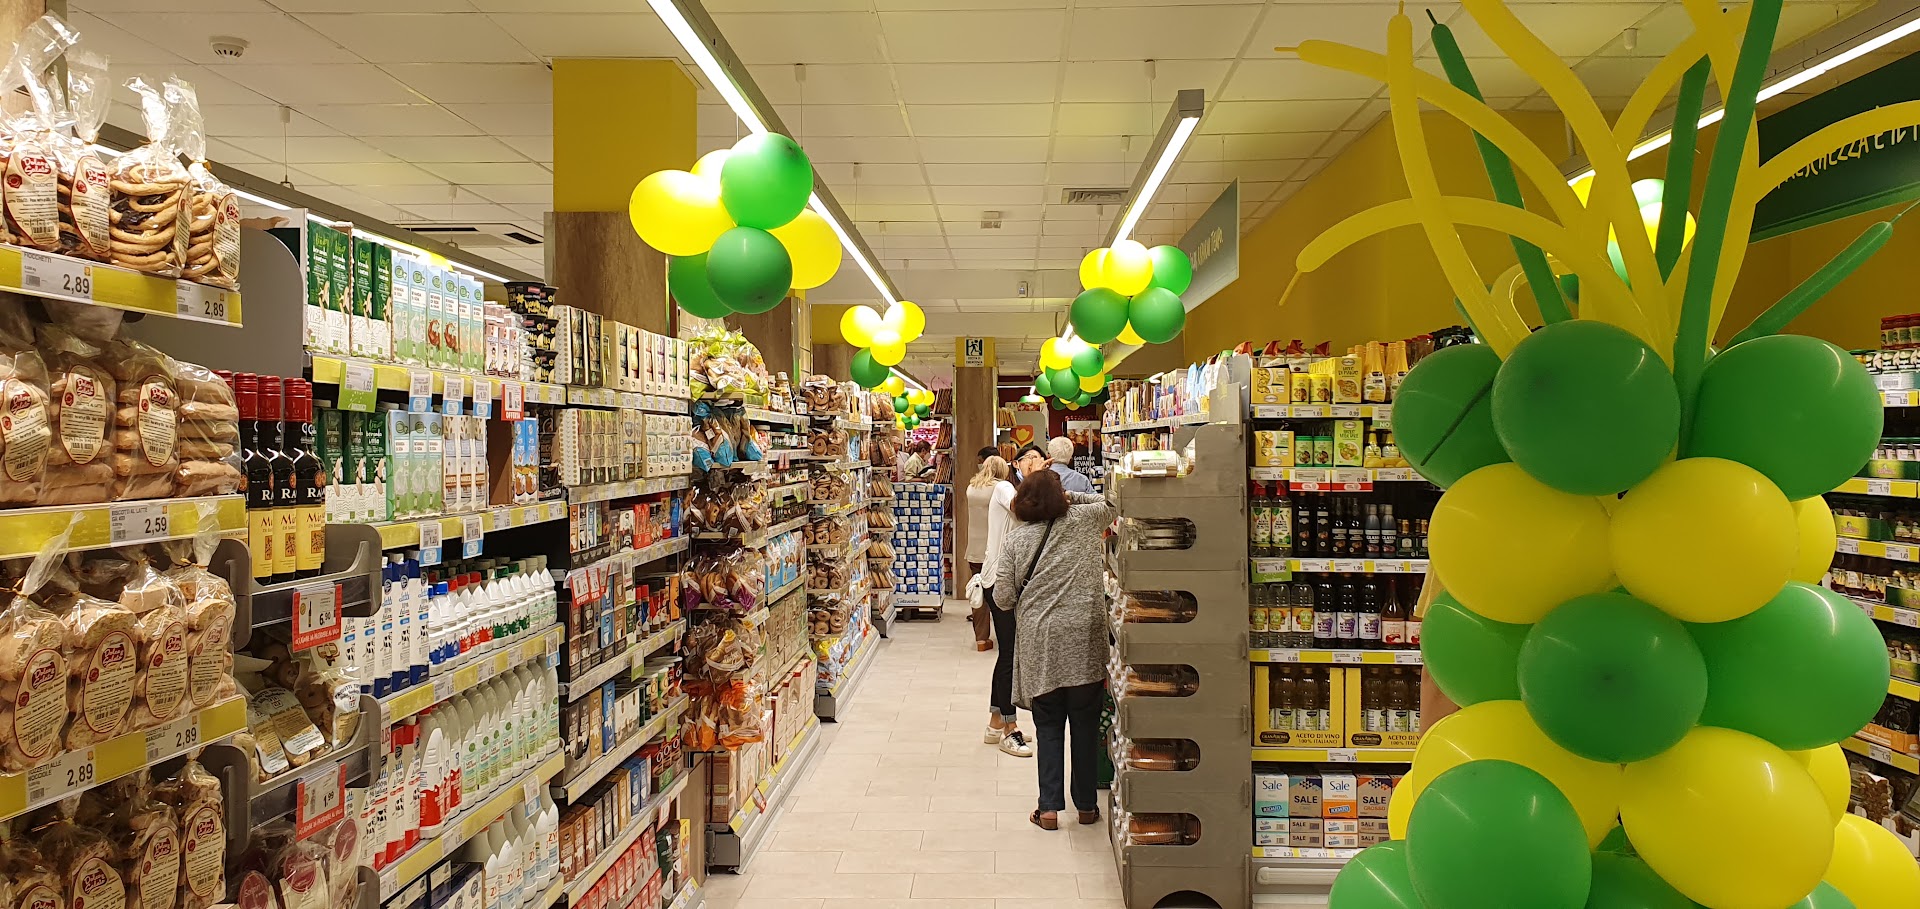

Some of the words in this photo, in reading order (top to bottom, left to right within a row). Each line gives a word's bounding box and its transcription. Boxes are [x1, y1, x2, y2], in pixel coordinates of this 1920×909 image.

[63, 273, 90, 294] 2,89
[204, 300, 225, 319] 2,89
[505, 412, 521, 420] OFFERTA
[144, 516, 167, 536] 2,59
[176, 727, 198, 748] 2,89
[67, 762, 94, 788] 2,89
[1262, 780, 1282, 791] Sale
[1329, 780, 1350, 791] Sale
[1294, 795, 1318, 804] SALE
[1362, 796, 1387, 805] SALE
